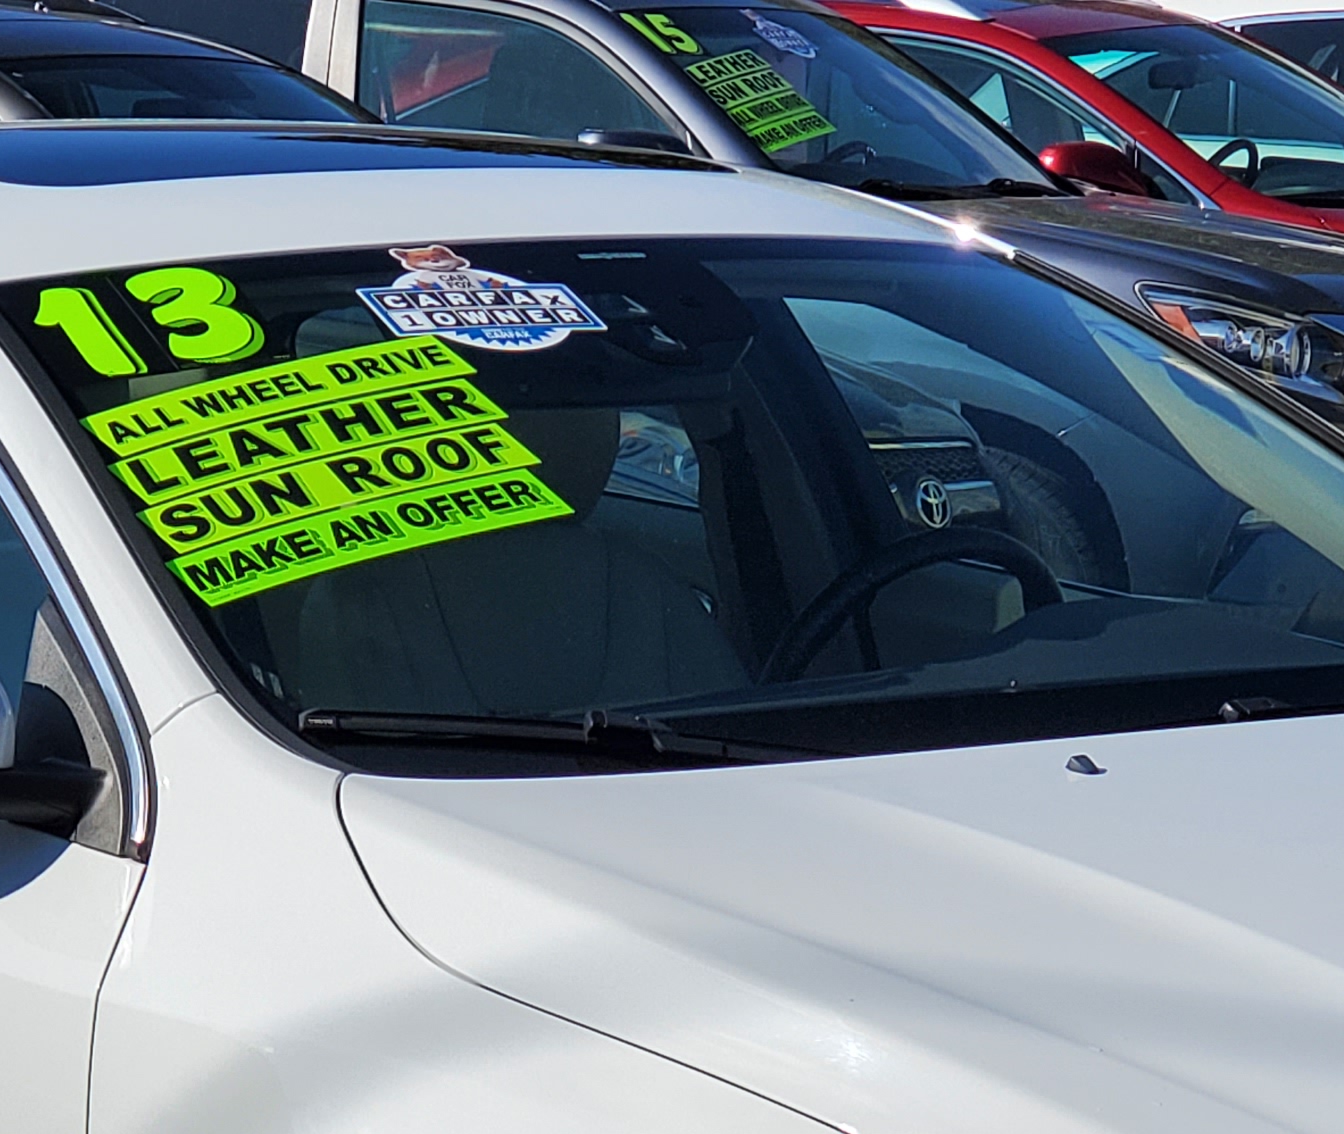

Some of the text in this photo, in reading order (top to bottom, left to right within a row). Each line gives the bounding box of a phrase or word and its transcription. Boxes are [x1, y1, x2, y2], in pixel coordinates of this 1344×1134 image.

[619, 13, 702, 54] 15
[687, 52, 766, 84] LEATHER
[709, 81, 749, 105] SUN
[741, 71, 786, 94] ROOF
[34, 267, 264, 378] 13
[383, 291, 567, 309] CARFAX
[399, 308, 585, 328] 1 OWNER
[107, 344, 454, 445] ALL WHEEL DRIVE
[126, 385, 490, 495] LEATHER
[159, 427, 512, 543] SUN ROOF
[183, 480, 546, 592] MAKE AN OFFER
